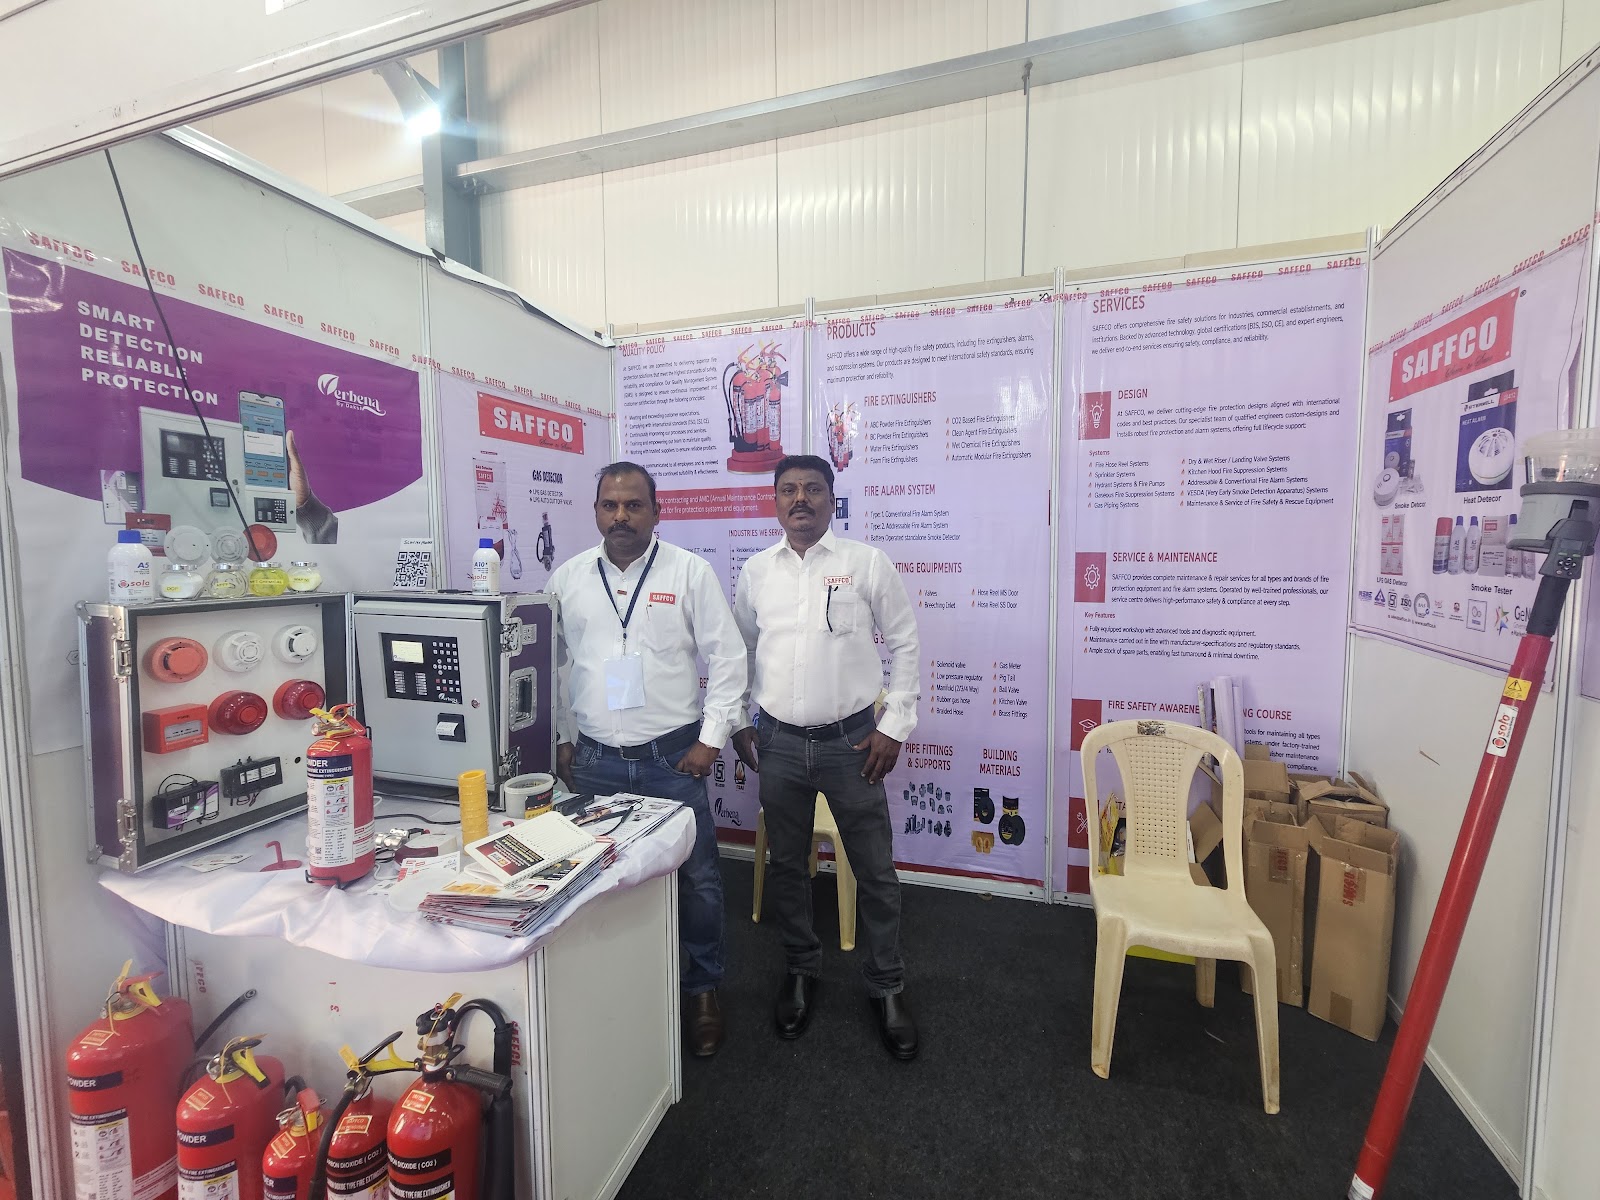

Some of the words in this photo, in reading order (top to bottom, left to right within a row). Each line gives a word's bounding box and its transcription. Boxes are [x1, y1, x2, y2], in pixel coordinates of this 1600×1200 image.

[1278, 264, 1311, 276] SAFFCO
[1327, 258, 1361, 269] SAFFCO
[121, 260, 176, 286] SAFCO
[198, 284, 244, 306] SAFFCO
[1092, 295, 1145, 314] SERVICES
[77, 301, 155, 332] SMART
[264, 304, 304, 325] SAFFCO
[320, 323, 355, 341] SAFFCO
[827, 322, 876, 341] PRODUCTS
[80, 323, 203, 364] DETECTION
[369, 339, 399, 355] SAFFCO
[1401, 316, 1498, 384] SAFFCO
[622, 347, 645, 357] QUALITY
[646, 345, 665, 355] POLICY
[81, 345, 187, 380] RELIABLE
[82, 368, 218, 405] PROTECTION
[864, 395, 879, 407] FIRE
[880, 391, 937, 406] EXTINGUISHERS
[1118, 388, 1148, 400] DESIGN
[493, 407, 573, 443] SAFFCO
[951, 441, 960, 449] Wet
[960, 440, 981, 448] Chemical
[981, 440, 990, 448] Fire
[991, 439, 1020, 449] Extinguishers
[951, 453, 973, 461] Automatic
[973, 452, 992, 461] Modular
[992, 452, 1001, 460] Fire
[1001, 451, 1031, 461] Extinguishers
[1188, 458, 1197, 466] Dry
[1231, 456, 1253, 465] Landing
[1268, 455, 1290, 464] Systems
[533, 470, 542, 481] GAS
[543, 471, 563, 484] DETECTOR
[1285, 476, 1308, 485] Systems
[864, 485, 879, 497] FIRE
[880, 485, 906, 496] ALARM
[907, 484, 935, 495] SYSTEM
[1261, 498, 1278, 507] Safety
[1304, 497, 1334, 506] Equipment
[728, 529, 758, 537] INDUSTRIES
[769, 528, 783, 536] SERVE
[871, 534, 884, 543] Battery
[884, 533, 904, 542] Operated
[904, 533, 927, 541] standalone
[1112, 552, 1146, 562] SERVICE
[1156, 552, 1217, 563] MAINTENANCE
[916, 562, 962, 573] EQUIPMENTS
[1471, 584, 1492, 592] Smoke
[1495, 586, 1512, 595] Tester
[1401, 598, 1412, 607] ISO
[1084, 611, 1094, 620] Key
[1094, 611, 1115, 619] Features
[936, 672, 945, 680] Low
[945, 674, 963, 682] pressure
[963, 673, 983, 683] regulator
[1108, 700, 1125, 711] FIRE
[1127, 701, 1157, 712] SAFETY
[1158, 703, 1200, 714] AWARENE
[1256, 710, 1292, 721] COURSE
[1498, 714, 1510, 736] solo
[1244, 728, 1257, 736] tools
[1266, 730, 1297, 740] maintaining
[1305, 732, 1320, 741] types
[905, 743, 921, 754] PIPE
[921, 744, 953, 756] FITTINGS
[983, 748, 1018, 762] BUILDING
[914, 757, 950, 771] SUPPORTS
[979, 764, 1020, 777] MATERIALS
[1287, 763, 1318, 773] compliance.
[177, 1130, 207, 1144] POWDER
[340, 1158, 363, 1169] DIOXIDE
[367, 1149, 379, 1160] CO2
[398, 1160, 417, 1170] DIOXIDE
[421, 1160, 433, 1169] CO2
